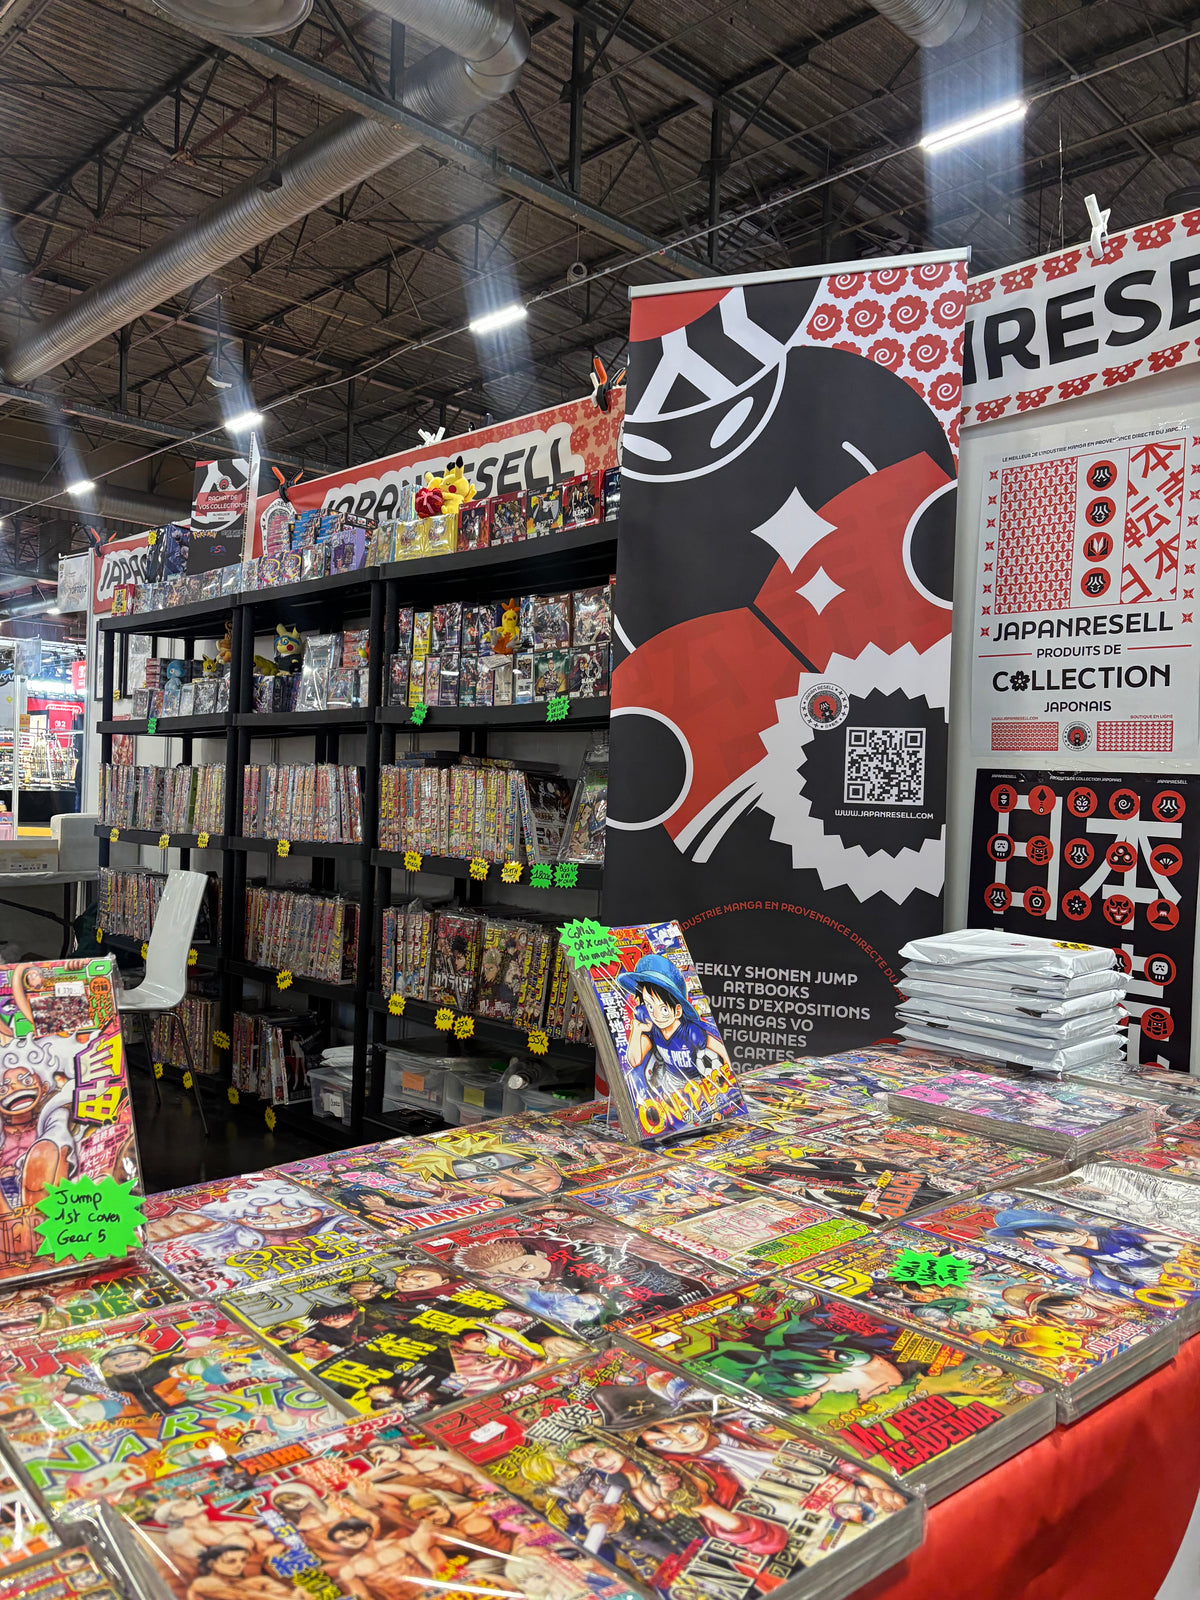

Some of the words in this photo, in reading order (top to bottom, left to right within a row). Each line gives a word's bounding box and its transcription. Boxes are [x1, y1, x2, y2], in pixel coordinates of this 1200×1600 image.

[1038, 446, 1067, 456] L'INDUSTRIE
[1132, 430, 1155, 440] DIRECTE
[993, 611, 1174, 642] JAPANRESELL
[1036, 645, 1100, 658] PRODUITS
[1104, 644, 1122, 655] DE
[1044, 700, 1112, 712] JAPONAIS
[834, 809, 934, 820] WWW.JAPANRESELL.COM
[567, 925, 595, 938] Collab
[723, 900, 763, 912] MANGA
[764, 900, 779, 910] EN
[780, 902, 852, 937] PROVENANCE
[849, 932, 888, 970] DIRECTE
[884, 968, 899, 984] DU
[574, 940, 584, 951] OP
[586, 939, 592, 949] X
[578, 952, 590, 962] du
[694, 962, 742, 979] EEKLY
[744, 966, 812, 983] SHONEN
[814, 972, 858, 986] JUMP
[723, 980, 810, 999] ARTBOOKS
[749, 998, 871, 1020] D'EXPOSITIONS
[718, 1012, 787, 1030] MANGAS
[790, 1018, 814, 1032] VO
[723, 1028, 807, 1048] FIGURINES
[734, 1046, 795, 1062] CARTES
[638, 1084, 691, 1134] ONE
[685, 1064, 737, 1112] PIECE
[54, 1190, 103, 1211] Jump
[872, 1171, 927, 1218] BLEACH
[54, 1208, 79, 1224] 1st
[88, 1211, 120, 1223] cover
[404, 1198, 506, 1230] NARUTO
[56, 1229, 92, 1246] Gear
[98, 1228, 106, 1243] 5
[226, 1230, 349, 1268] ONE
[238, 1242, 367, 1282] PIECE
[1084, 1336, 1120, 1354] ONE
[1104, 1321, 1146, 1341] PIECE
[24, 1379, 330, 1490] NARUTO
[836, 1422, 897, 1460] MY
[883, 1394, 959, 1436] HERO
[878, 1400, 1006, 1476] ACADEMIA
